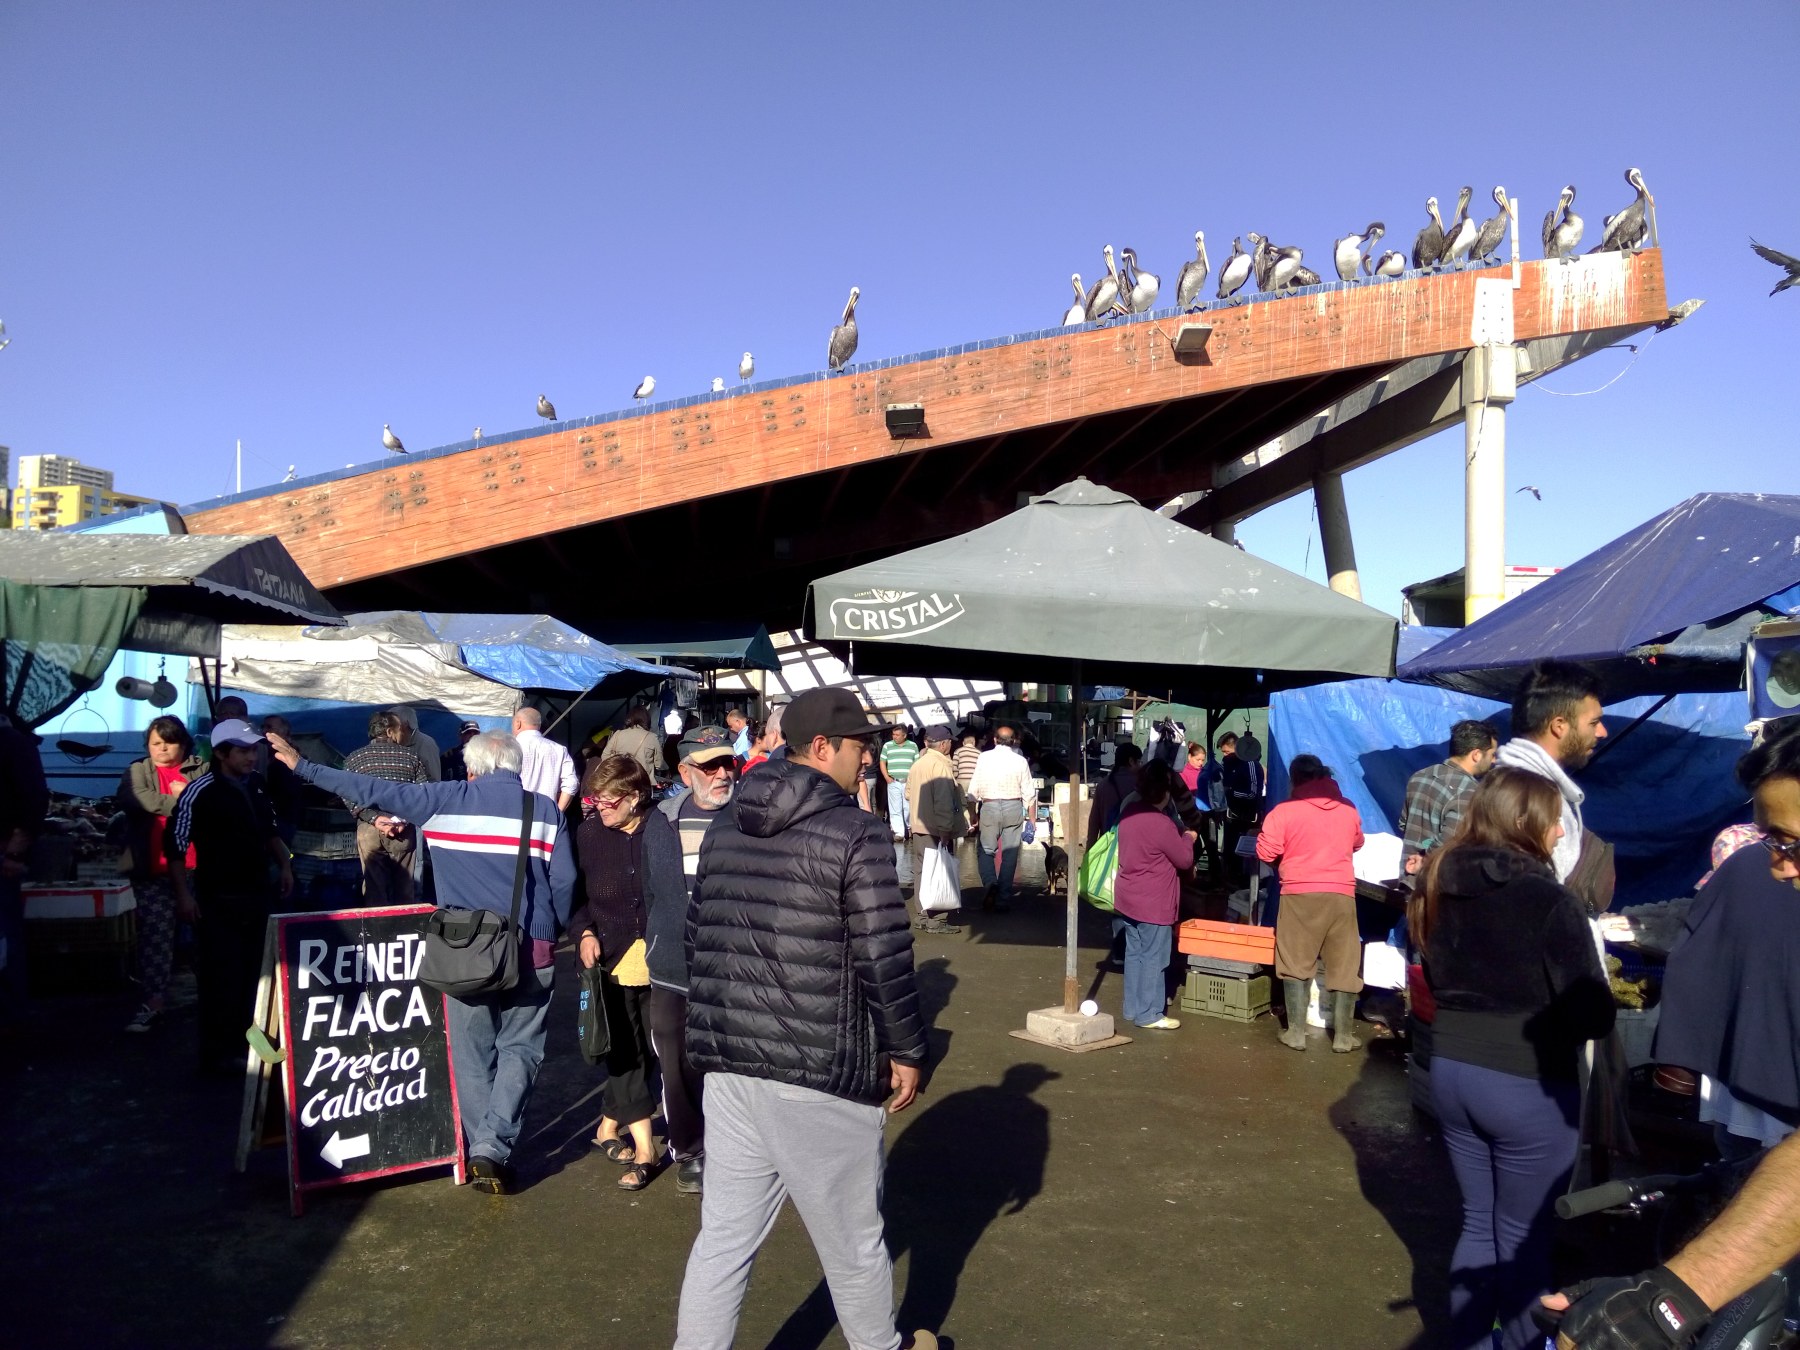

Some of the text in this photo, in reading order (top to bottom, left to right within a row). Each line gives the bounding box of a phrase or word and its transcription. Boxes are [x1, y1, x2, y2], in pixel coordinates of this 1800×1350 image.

[253, 567, 308, 607] TATIANA
[844, 592, 954, 631] CRISTAL
[302, 986, 431, 1041] FLACA
[303, 1045, 420, 1088] Precio
[301, 1067, 428, 1128] Calidad
[1659, 1301, 1682, 1330] DRB
